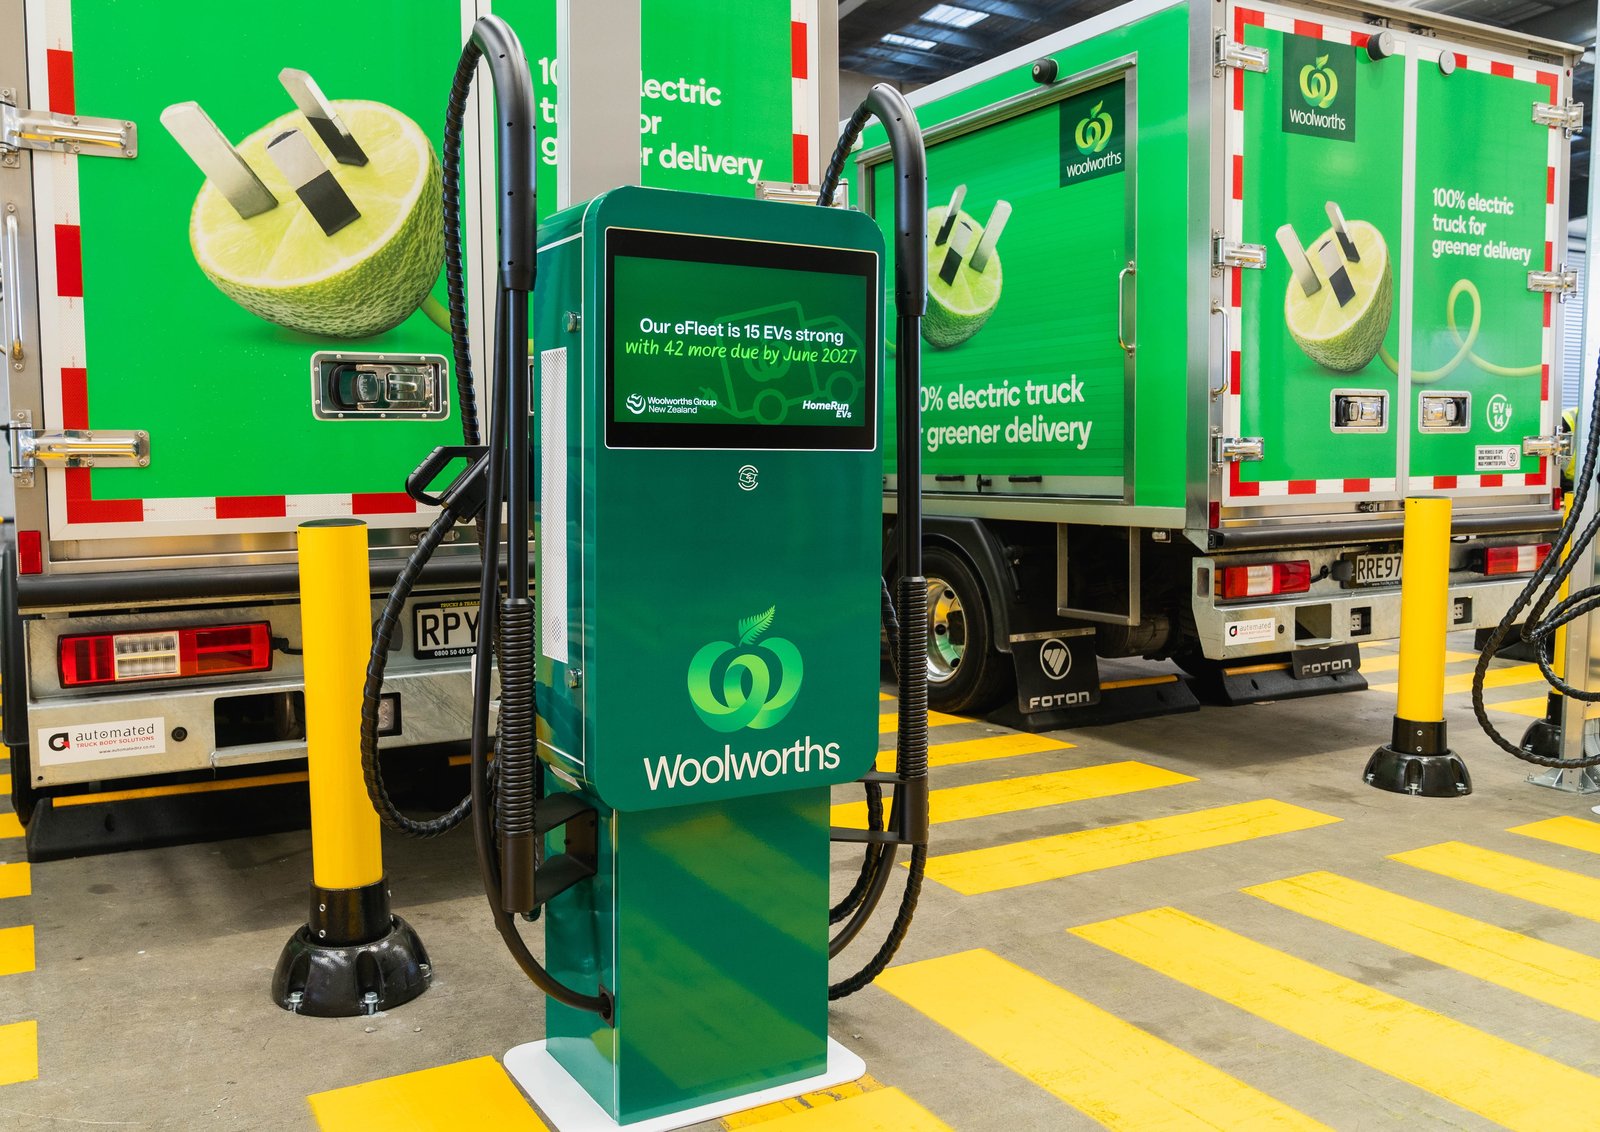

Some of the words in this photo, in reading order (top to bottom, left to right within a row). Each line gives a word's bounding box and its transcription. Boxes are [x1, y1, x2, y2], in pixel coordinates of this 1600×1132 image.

[640, 70, 721, 107] lectric
[640, 114, 662, 134] or
[1290, 108, 1346, 131] Woolworths
[659, 142, 763, 184] delivery
[1066, 151, 1122, 178] Woolworths
[1432, 188, 1465, 210] 100%
[1468, 192, 1514, 215] electric
[1432, 214, 1466, 234] truck
[1468, 216, 1486, 236] for
[1432, 239, 1482, 258] greener
[1484, 240, 1532, 266] delivery
[640, 318, 671, 334] Our
[675, 320, 723, 337] eFleet
[728, 322, 740, 338] is
[744, 324, 760, 338] 15
[764, 326, 792, 340] EVs
[796, 329, 843, 346] strong
[626, 339, 659, 355] with
[664, 340, 684, 356] 42
[688, 344, 726, 358] more
[731, 344, 759, 360] due
[764, 345, 779, 364] by
[783, 347, 818, 362] June
[821, 348, 857, 363] 2027
[647, 397, 692, 405] Woolworths
[693, 398, 717, 407] Group
[802, 400, 849, 410] HomeRun
[920, 385, 943, 412] 0%
[947, 380, 1020, 410] electric
[1025, 374, 1085, 405] truck
[836, 410, 852, 418] EVs
[1492, 402, 1505, 414] EV
[1494, 414, 1504, 427] 14
[927, 424, 1000, 452] greener
[1005, 414, 1092, 450] delivery
[1358, 556, 1401, 580] RRE97
[422, 611, 479, 646] RPY
[1302, 659, 1352, 675] FOTON
[1030, 691, 1090, 709] FOTON
[75, 724, 154, 742] automated
[644, 736, 840, 790] Woolworths
